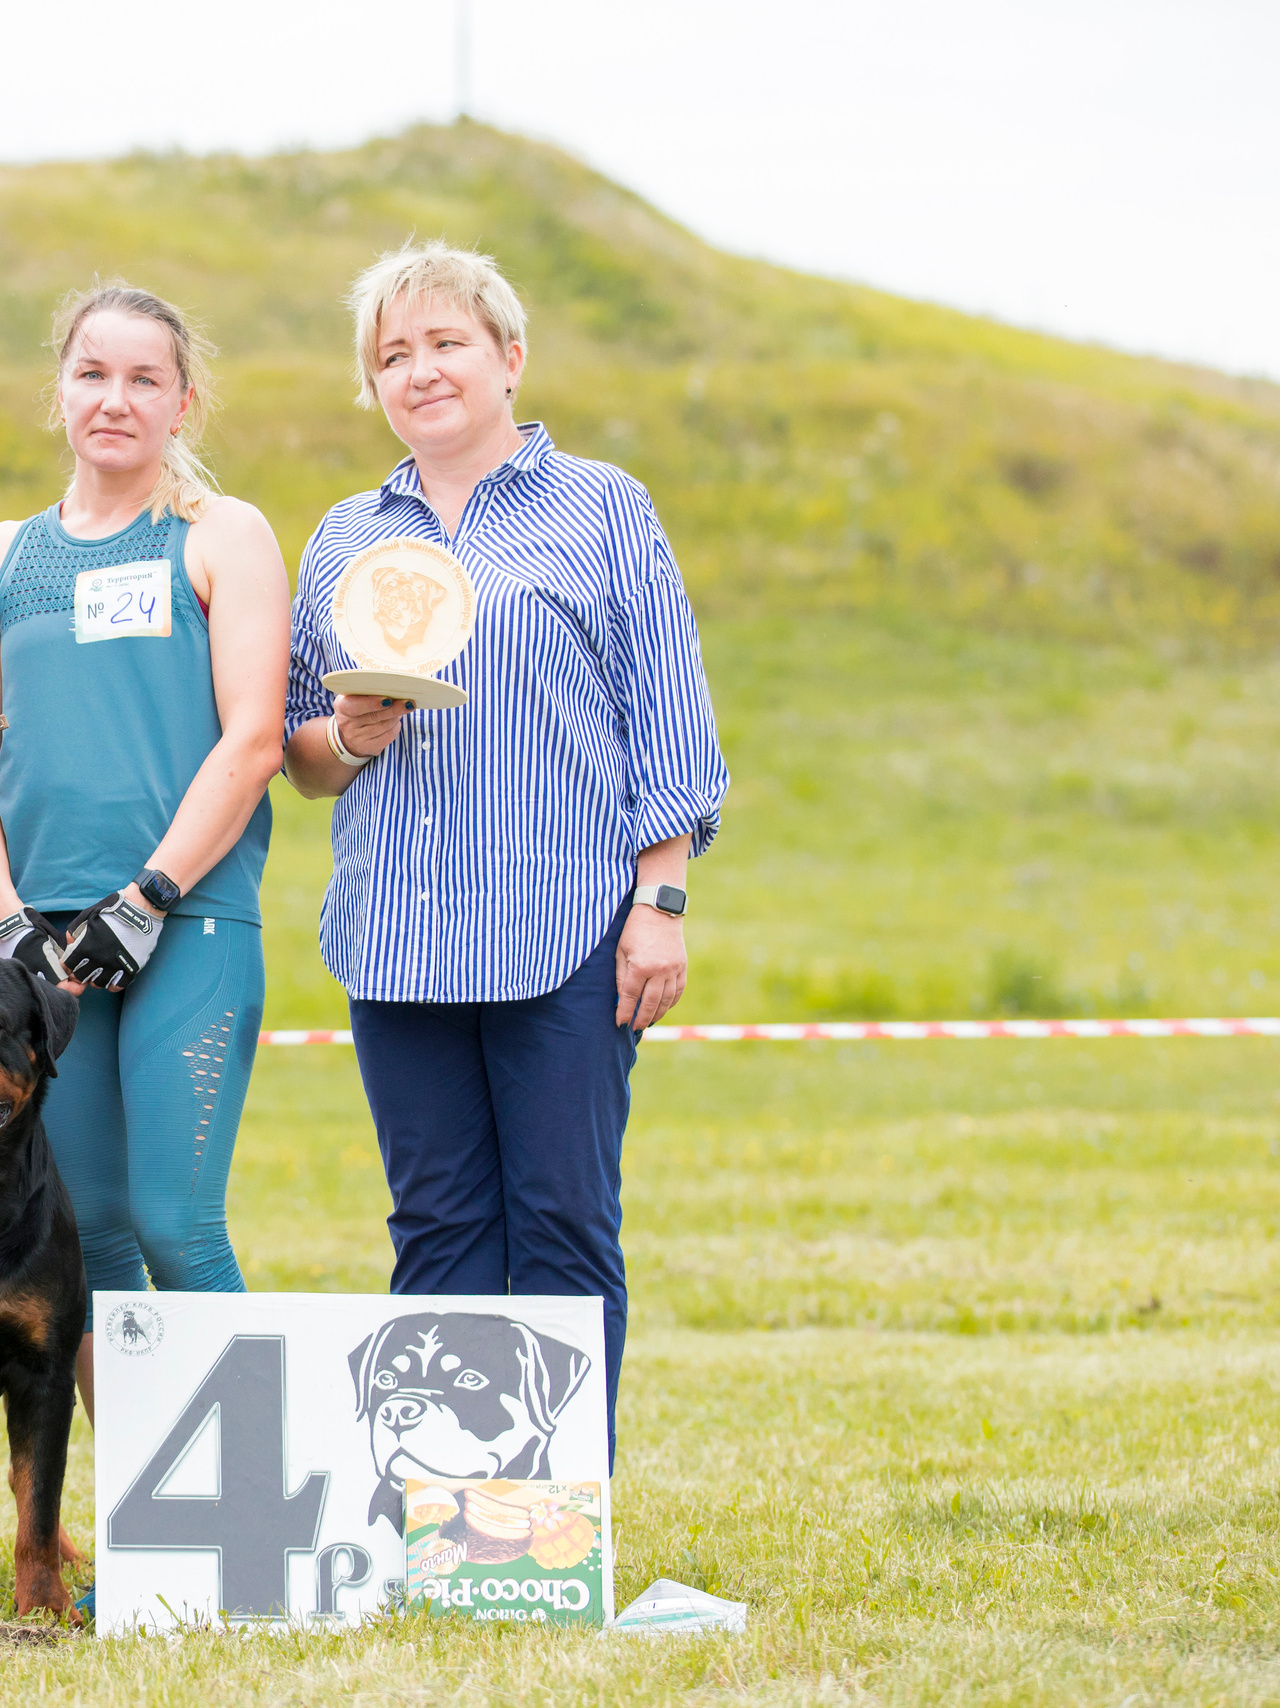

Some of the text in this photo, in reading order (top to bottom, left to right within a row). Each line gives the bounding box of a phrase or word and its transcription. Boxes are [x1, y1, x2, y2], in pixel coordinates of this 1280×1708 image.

[110, 591, 156, 624] 24
[334, 540, 400, 609] Межрегиональный
[402, 539, 455, 568] Чемпионат
[451, 565, 472, 631] Ротвейлеров
[107, 1333, 332, 1622] 4
[421, 1541, 468, 1572] Манго
